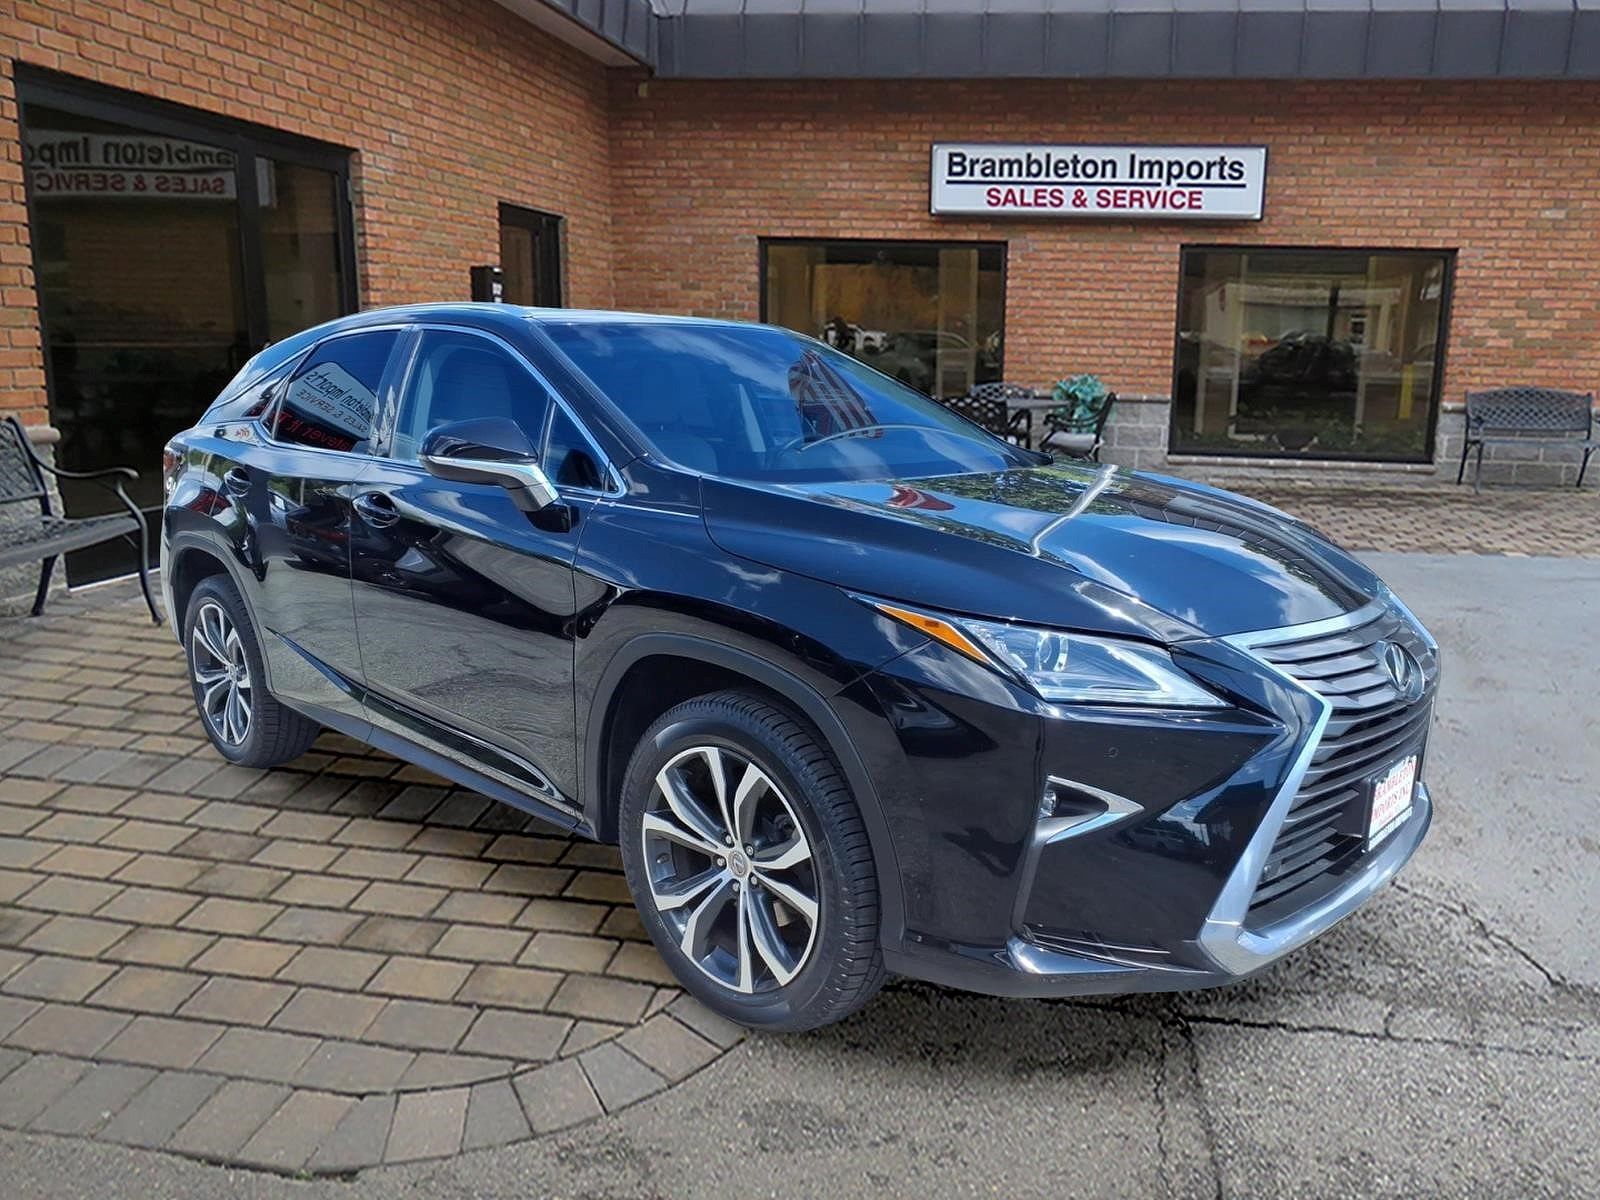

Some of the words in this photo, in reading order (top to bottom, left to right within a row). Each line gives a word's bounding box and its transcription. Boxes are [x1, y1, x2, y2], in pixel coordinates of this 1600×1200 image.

[948, 152, 1117, 179] Brambleton
[1128, 153, 1245, 187] Imports
[986, 188, 1064, 207] SALES
[1072, 189, 1087, 207] &
[1096, 189, 1203, 209] SERVICE
